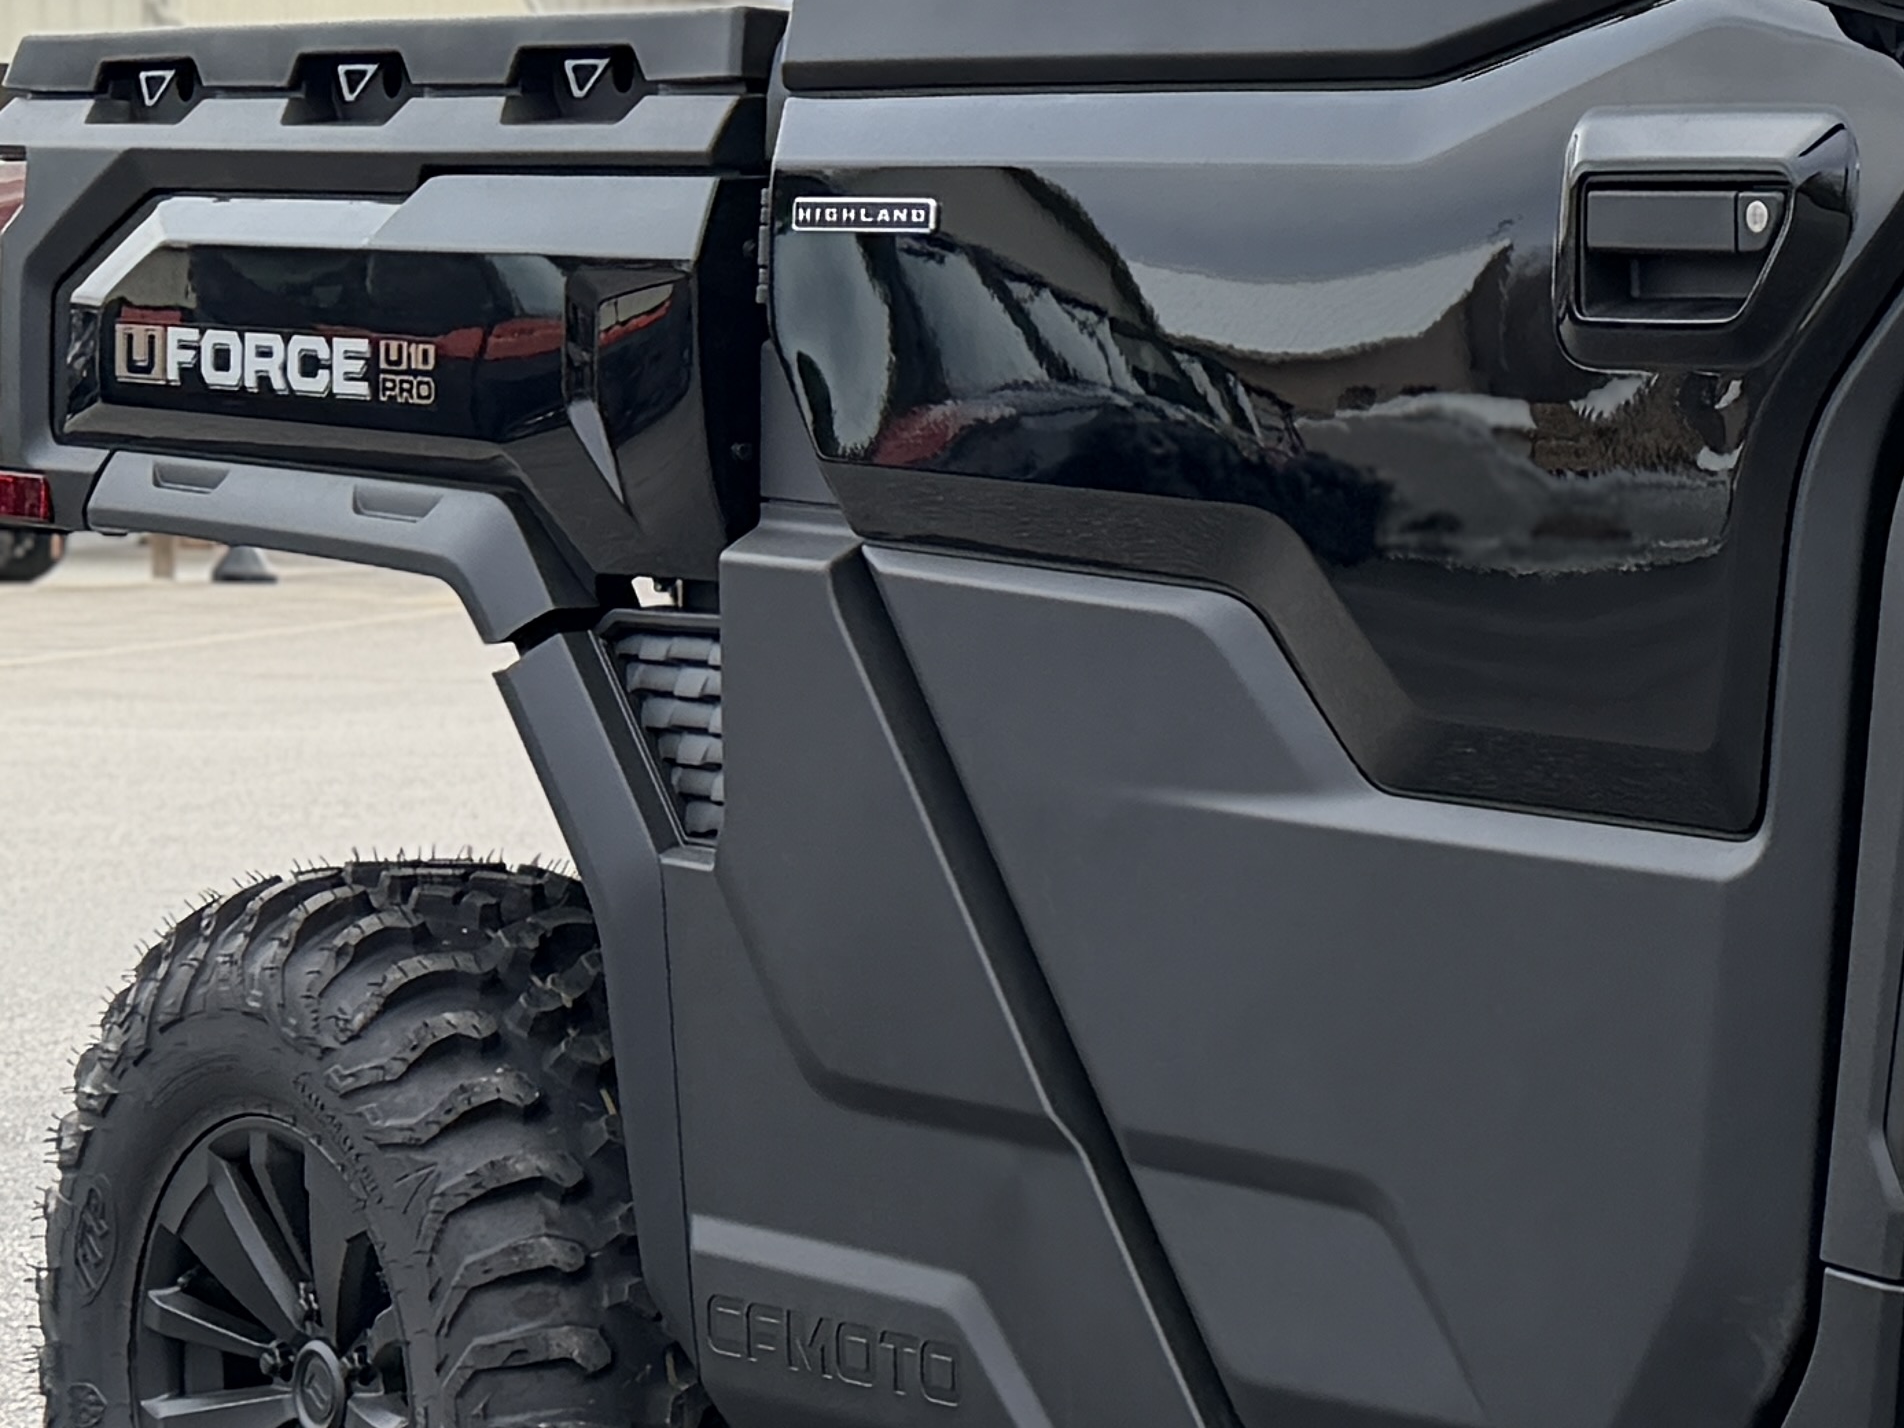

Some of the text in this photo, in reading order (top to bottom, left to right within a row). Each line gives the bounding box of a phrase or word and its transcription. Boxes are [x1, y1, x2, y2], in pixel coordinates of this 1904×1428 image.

[798, 208, 925, 222] HIGHLAND
[379, 340, 435, 370] U10
[379, 374, 435, 403] PRO
[707, 1294, 959, 1406] CFMOTO
